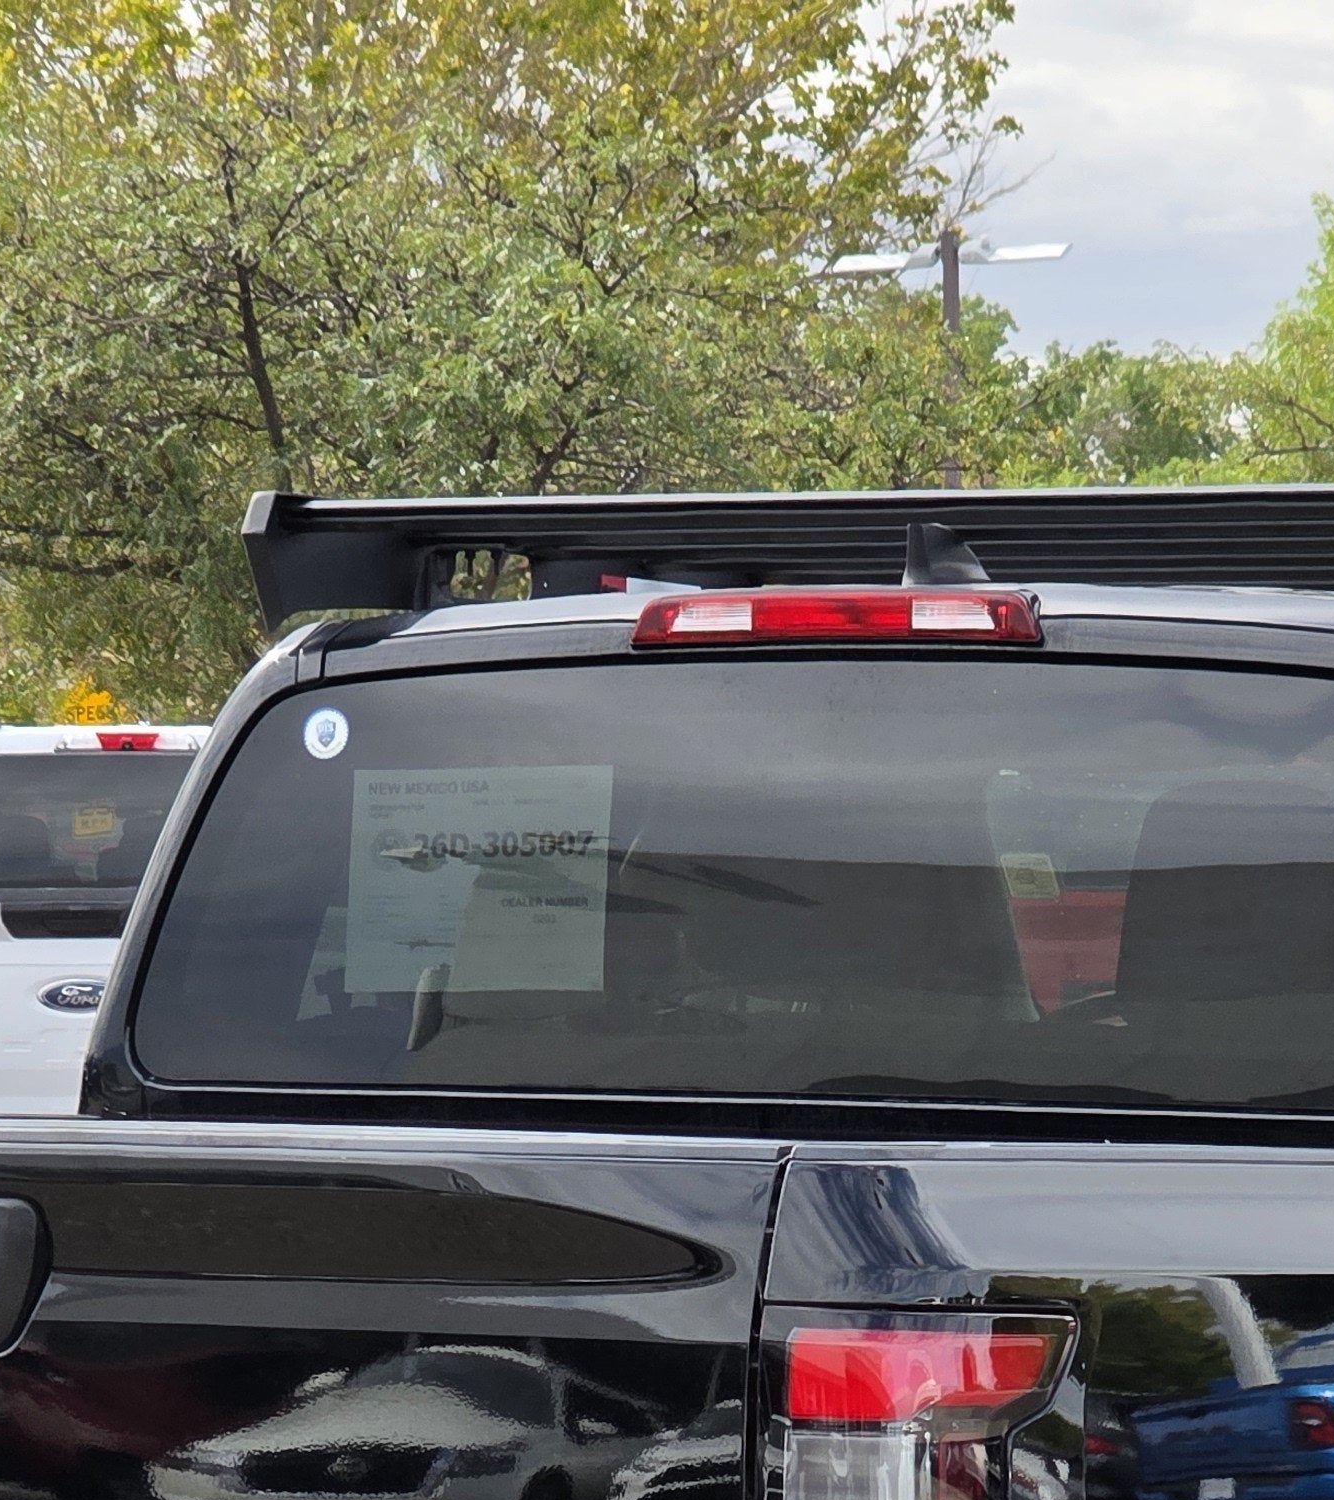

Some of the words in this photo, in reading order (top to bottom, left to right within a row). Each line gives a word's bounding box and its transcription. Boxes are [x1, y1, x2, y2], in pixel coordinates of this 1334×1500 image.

[368, 782, 401, 795] NEW
[405, 781, 457, 795] MEXICO
[462, 780, 489, 793] USA
